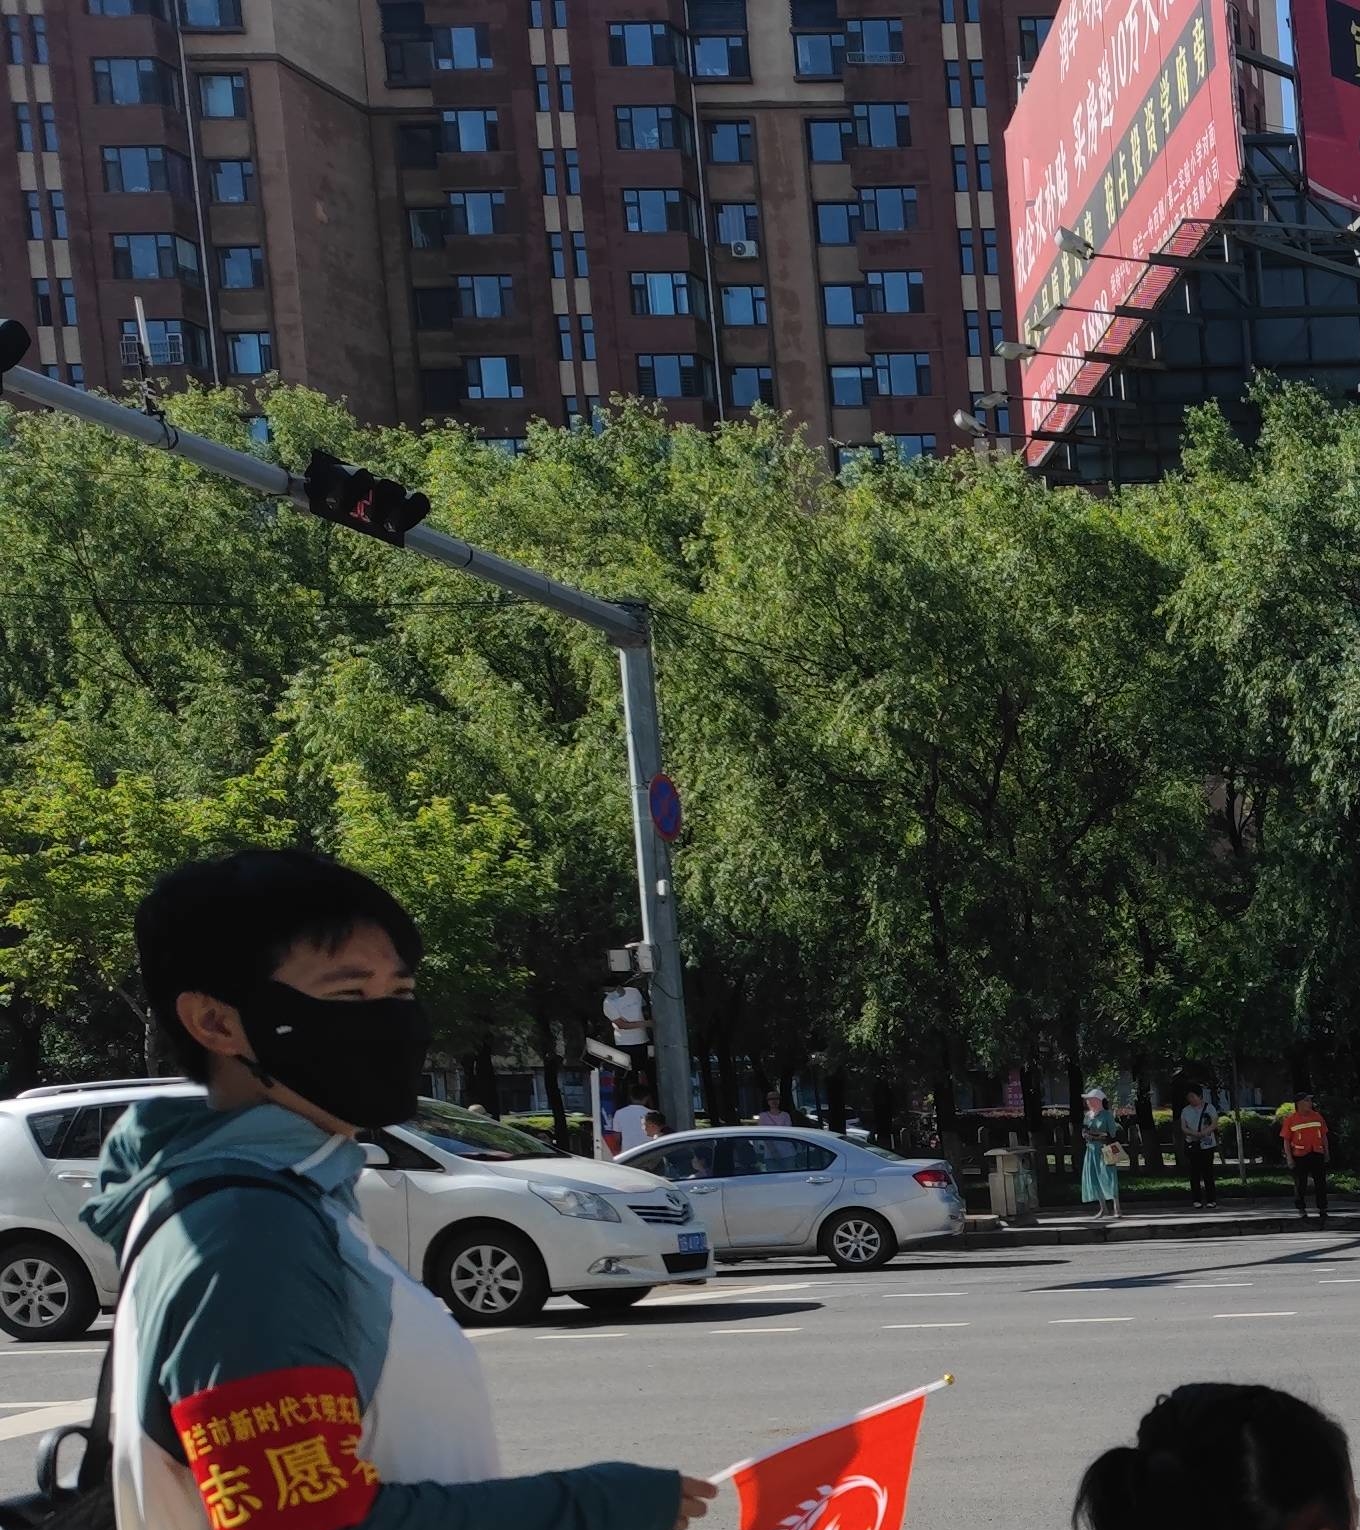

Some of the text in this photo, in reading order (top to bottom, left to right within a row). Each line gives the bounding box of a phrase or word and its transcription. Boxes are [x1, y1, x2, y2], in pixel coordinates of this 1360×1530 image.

[1073, 0, 1174, 188] 买房送10万大
